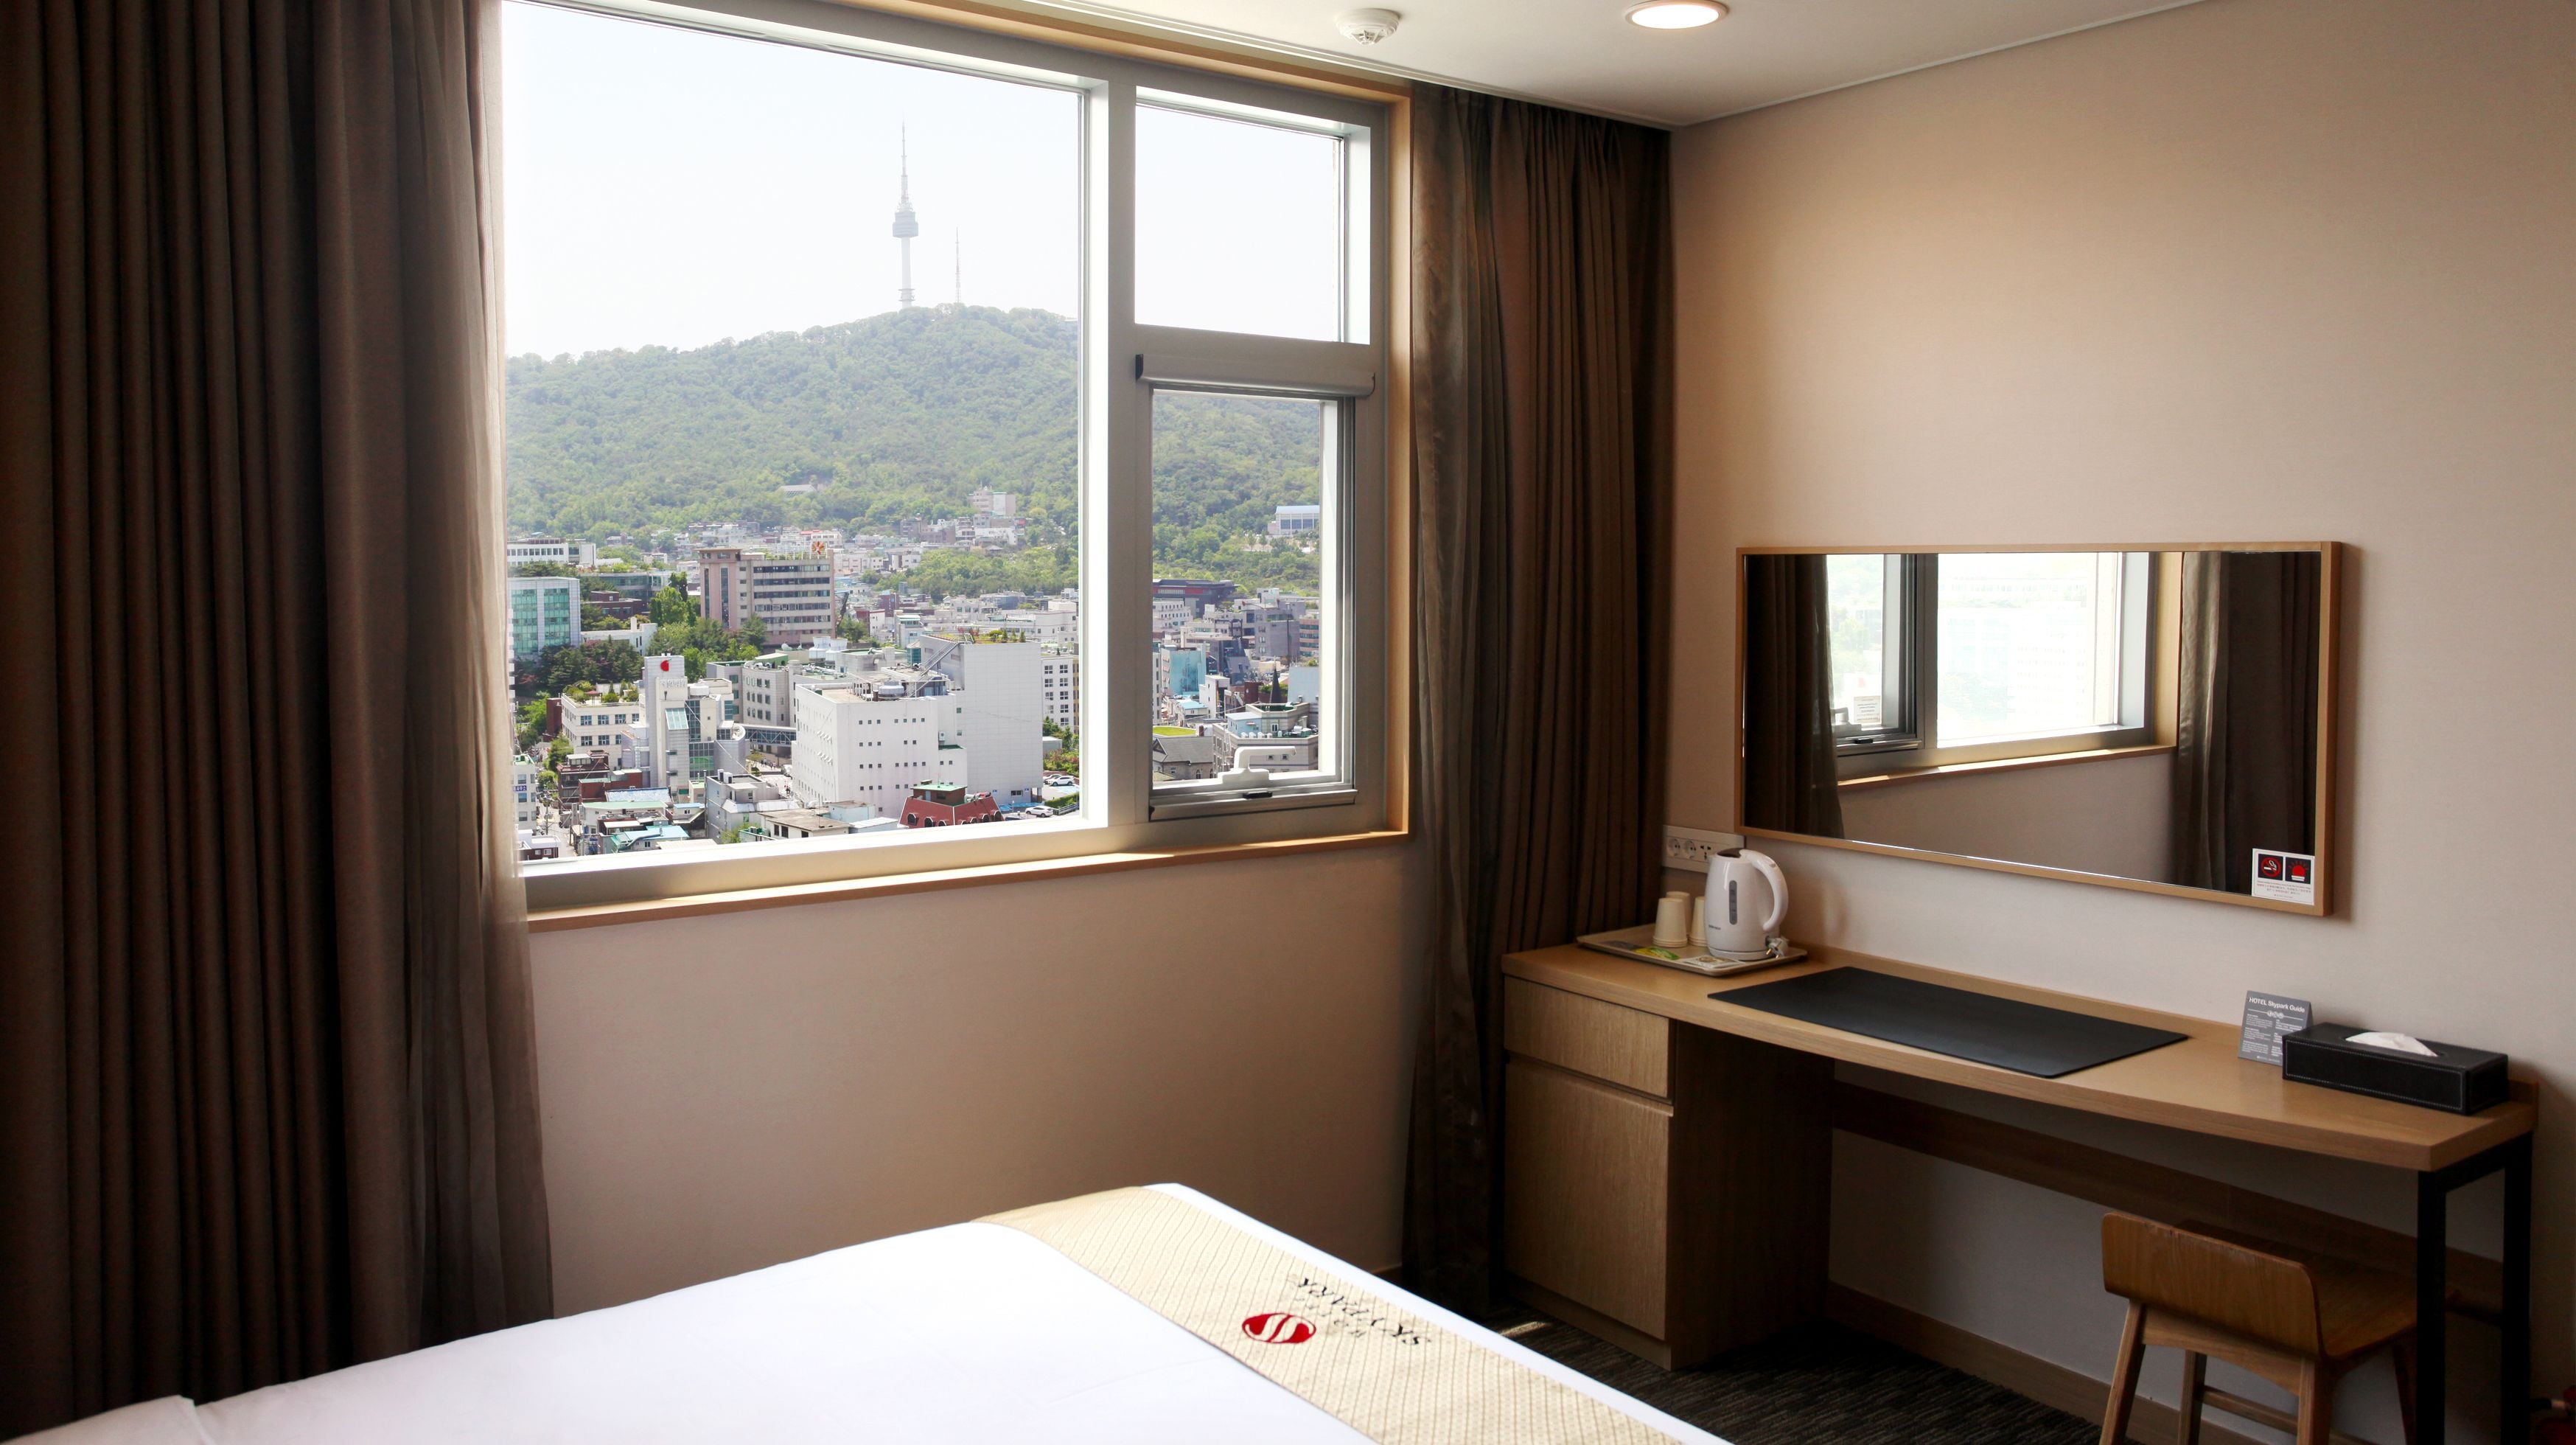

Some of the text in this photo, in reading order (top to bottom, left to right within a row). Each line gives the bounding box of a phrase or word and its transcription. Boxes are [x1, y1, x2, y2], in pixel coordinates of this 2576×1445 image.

[2249, 997, 2306, 1013] HOTEL Skypark Guide
[1295, 1277, 1432, 1345] SKYPARK
